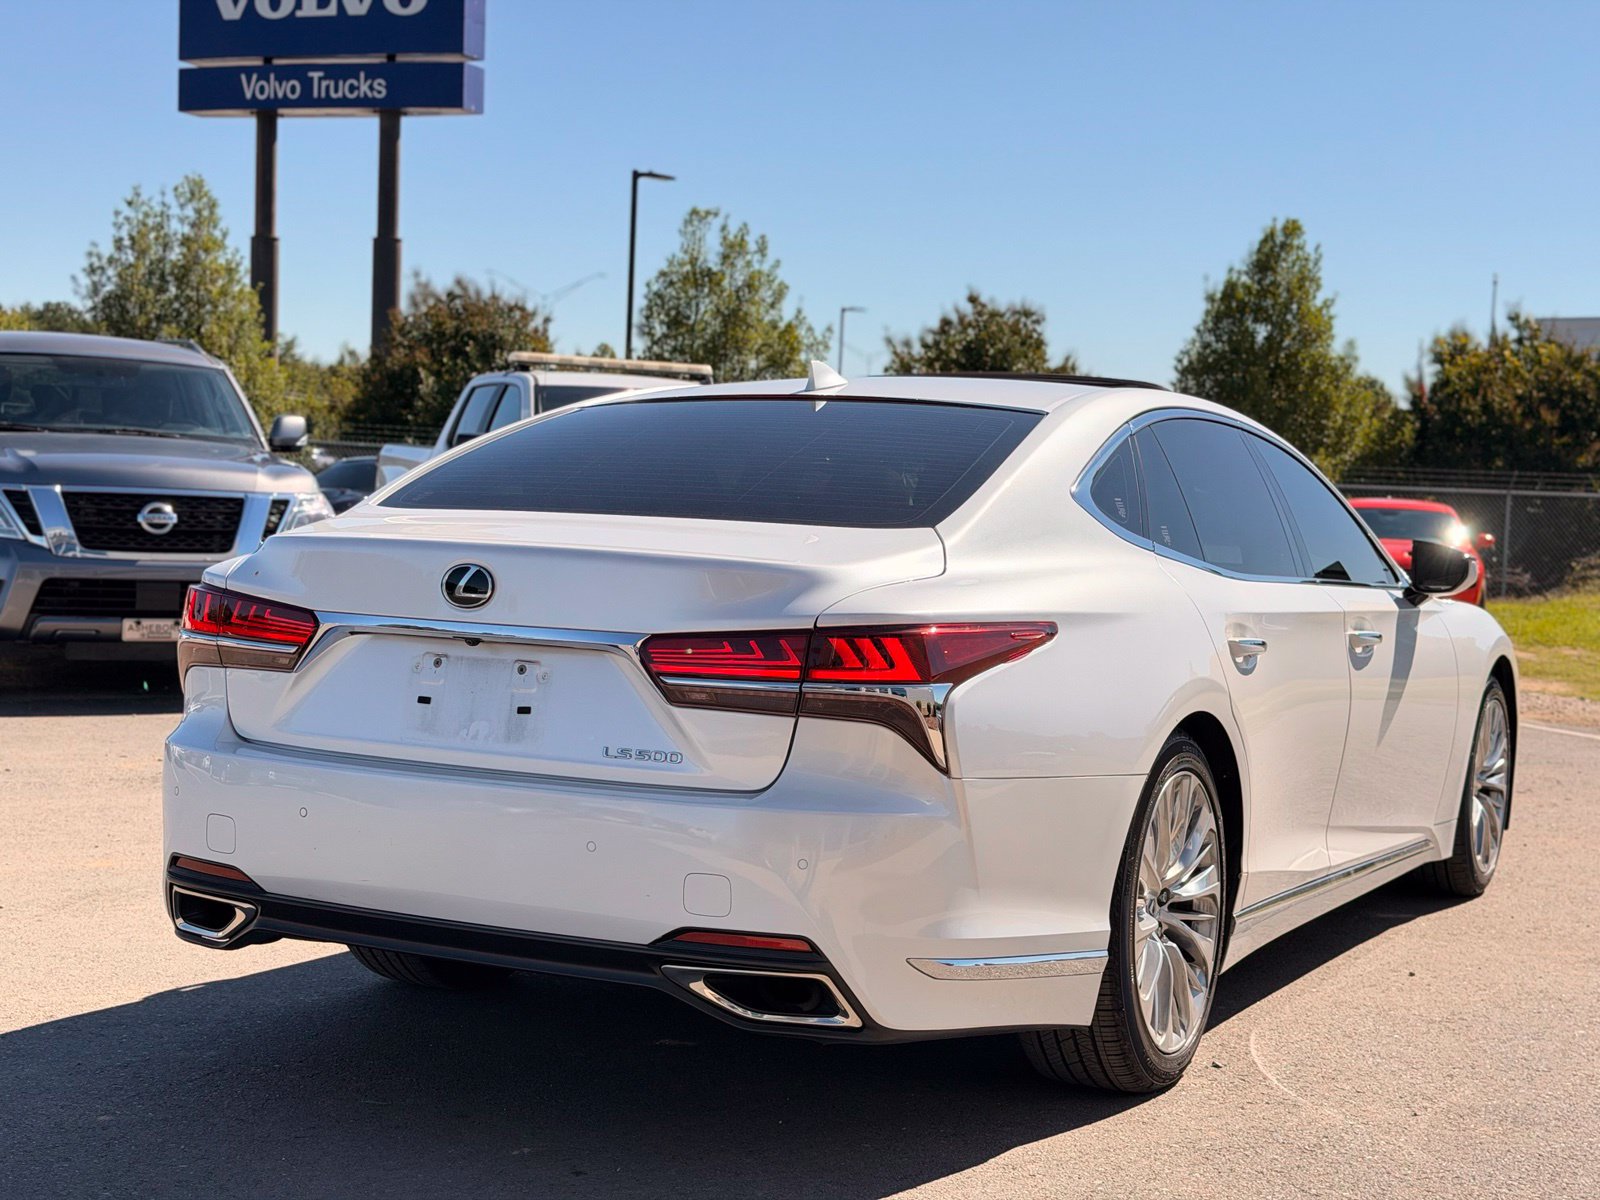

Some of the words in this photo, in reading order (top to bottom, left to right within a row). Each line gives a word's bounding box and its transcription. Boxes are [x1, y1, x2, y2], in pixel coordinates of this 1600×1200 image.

[240, 73, 301, 100] Volvo
[307, 71, 388, 99] Trucks
[634, 748, 684, 765] 500
